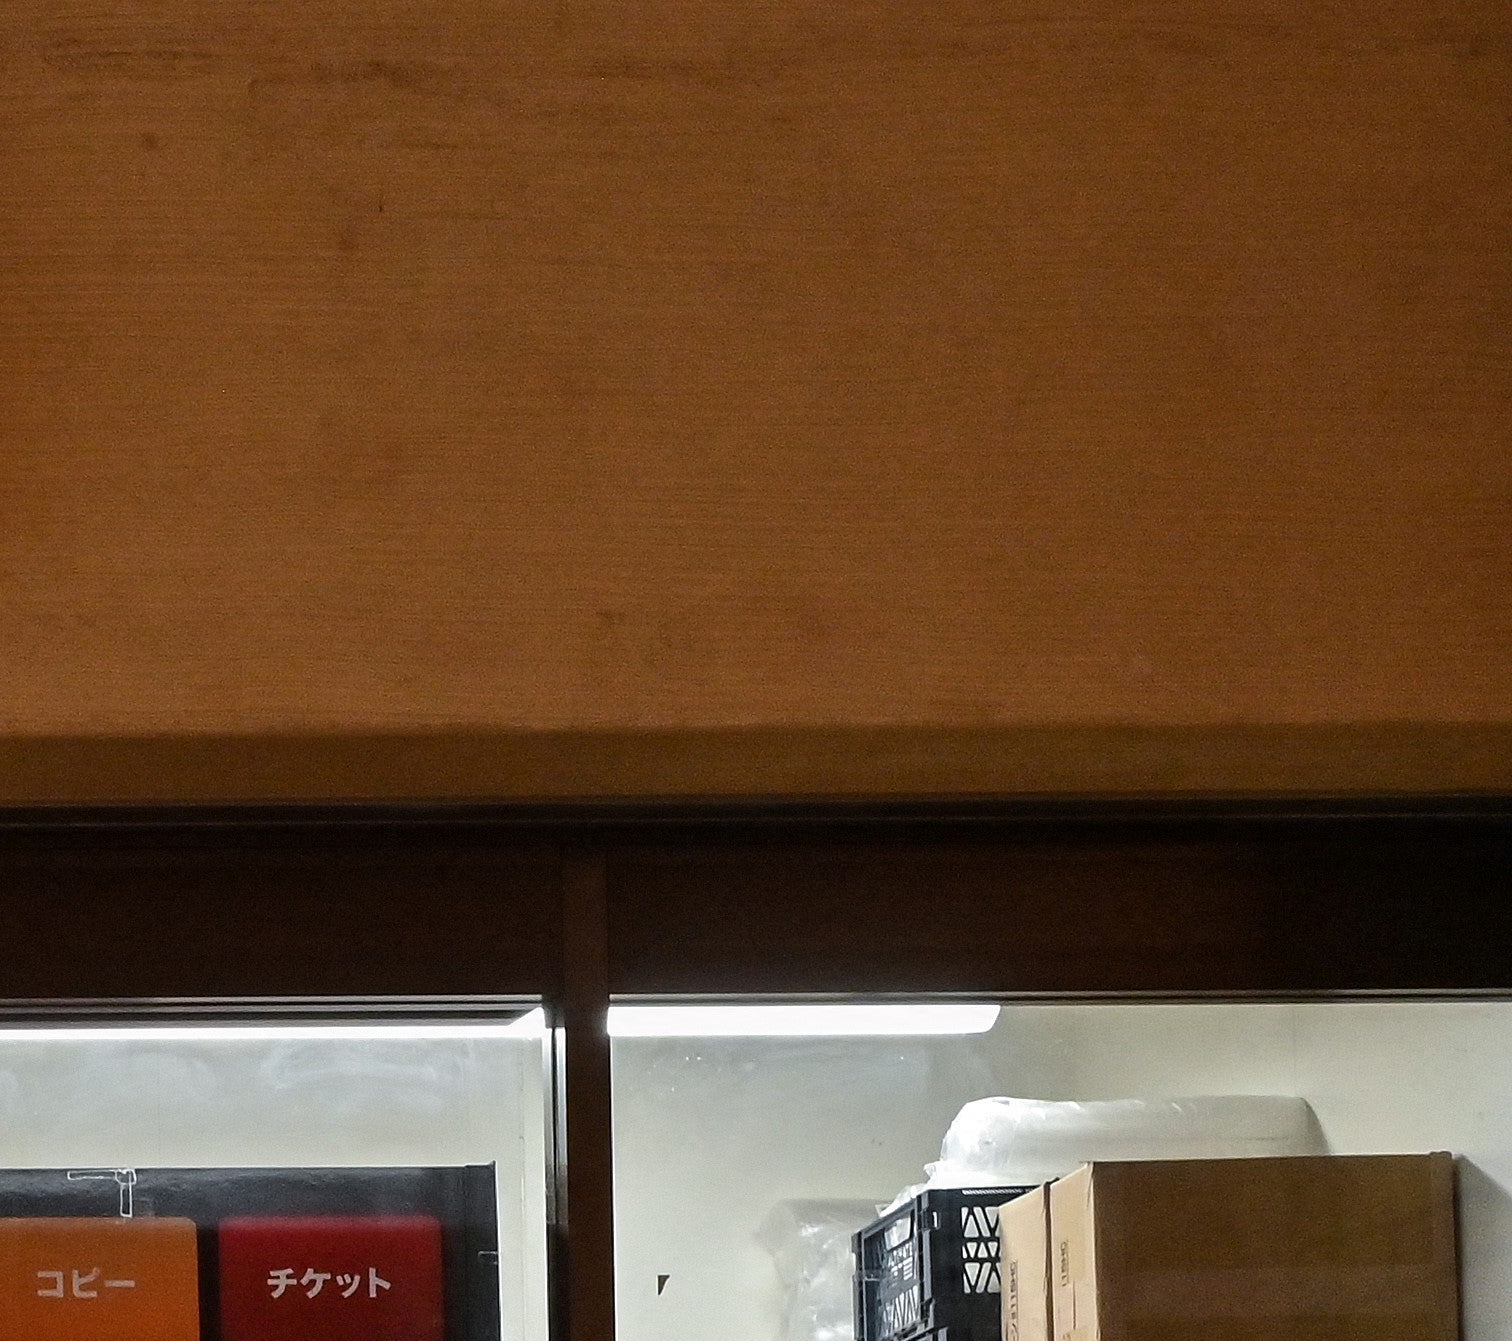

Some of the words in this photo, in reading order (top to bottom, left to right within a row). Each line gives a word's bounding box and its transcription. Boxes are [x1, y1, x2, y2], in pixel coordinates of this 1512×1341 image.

[37, 1267, 136, 1299] コピー
[266, 1267, 392, 1299] チケット
